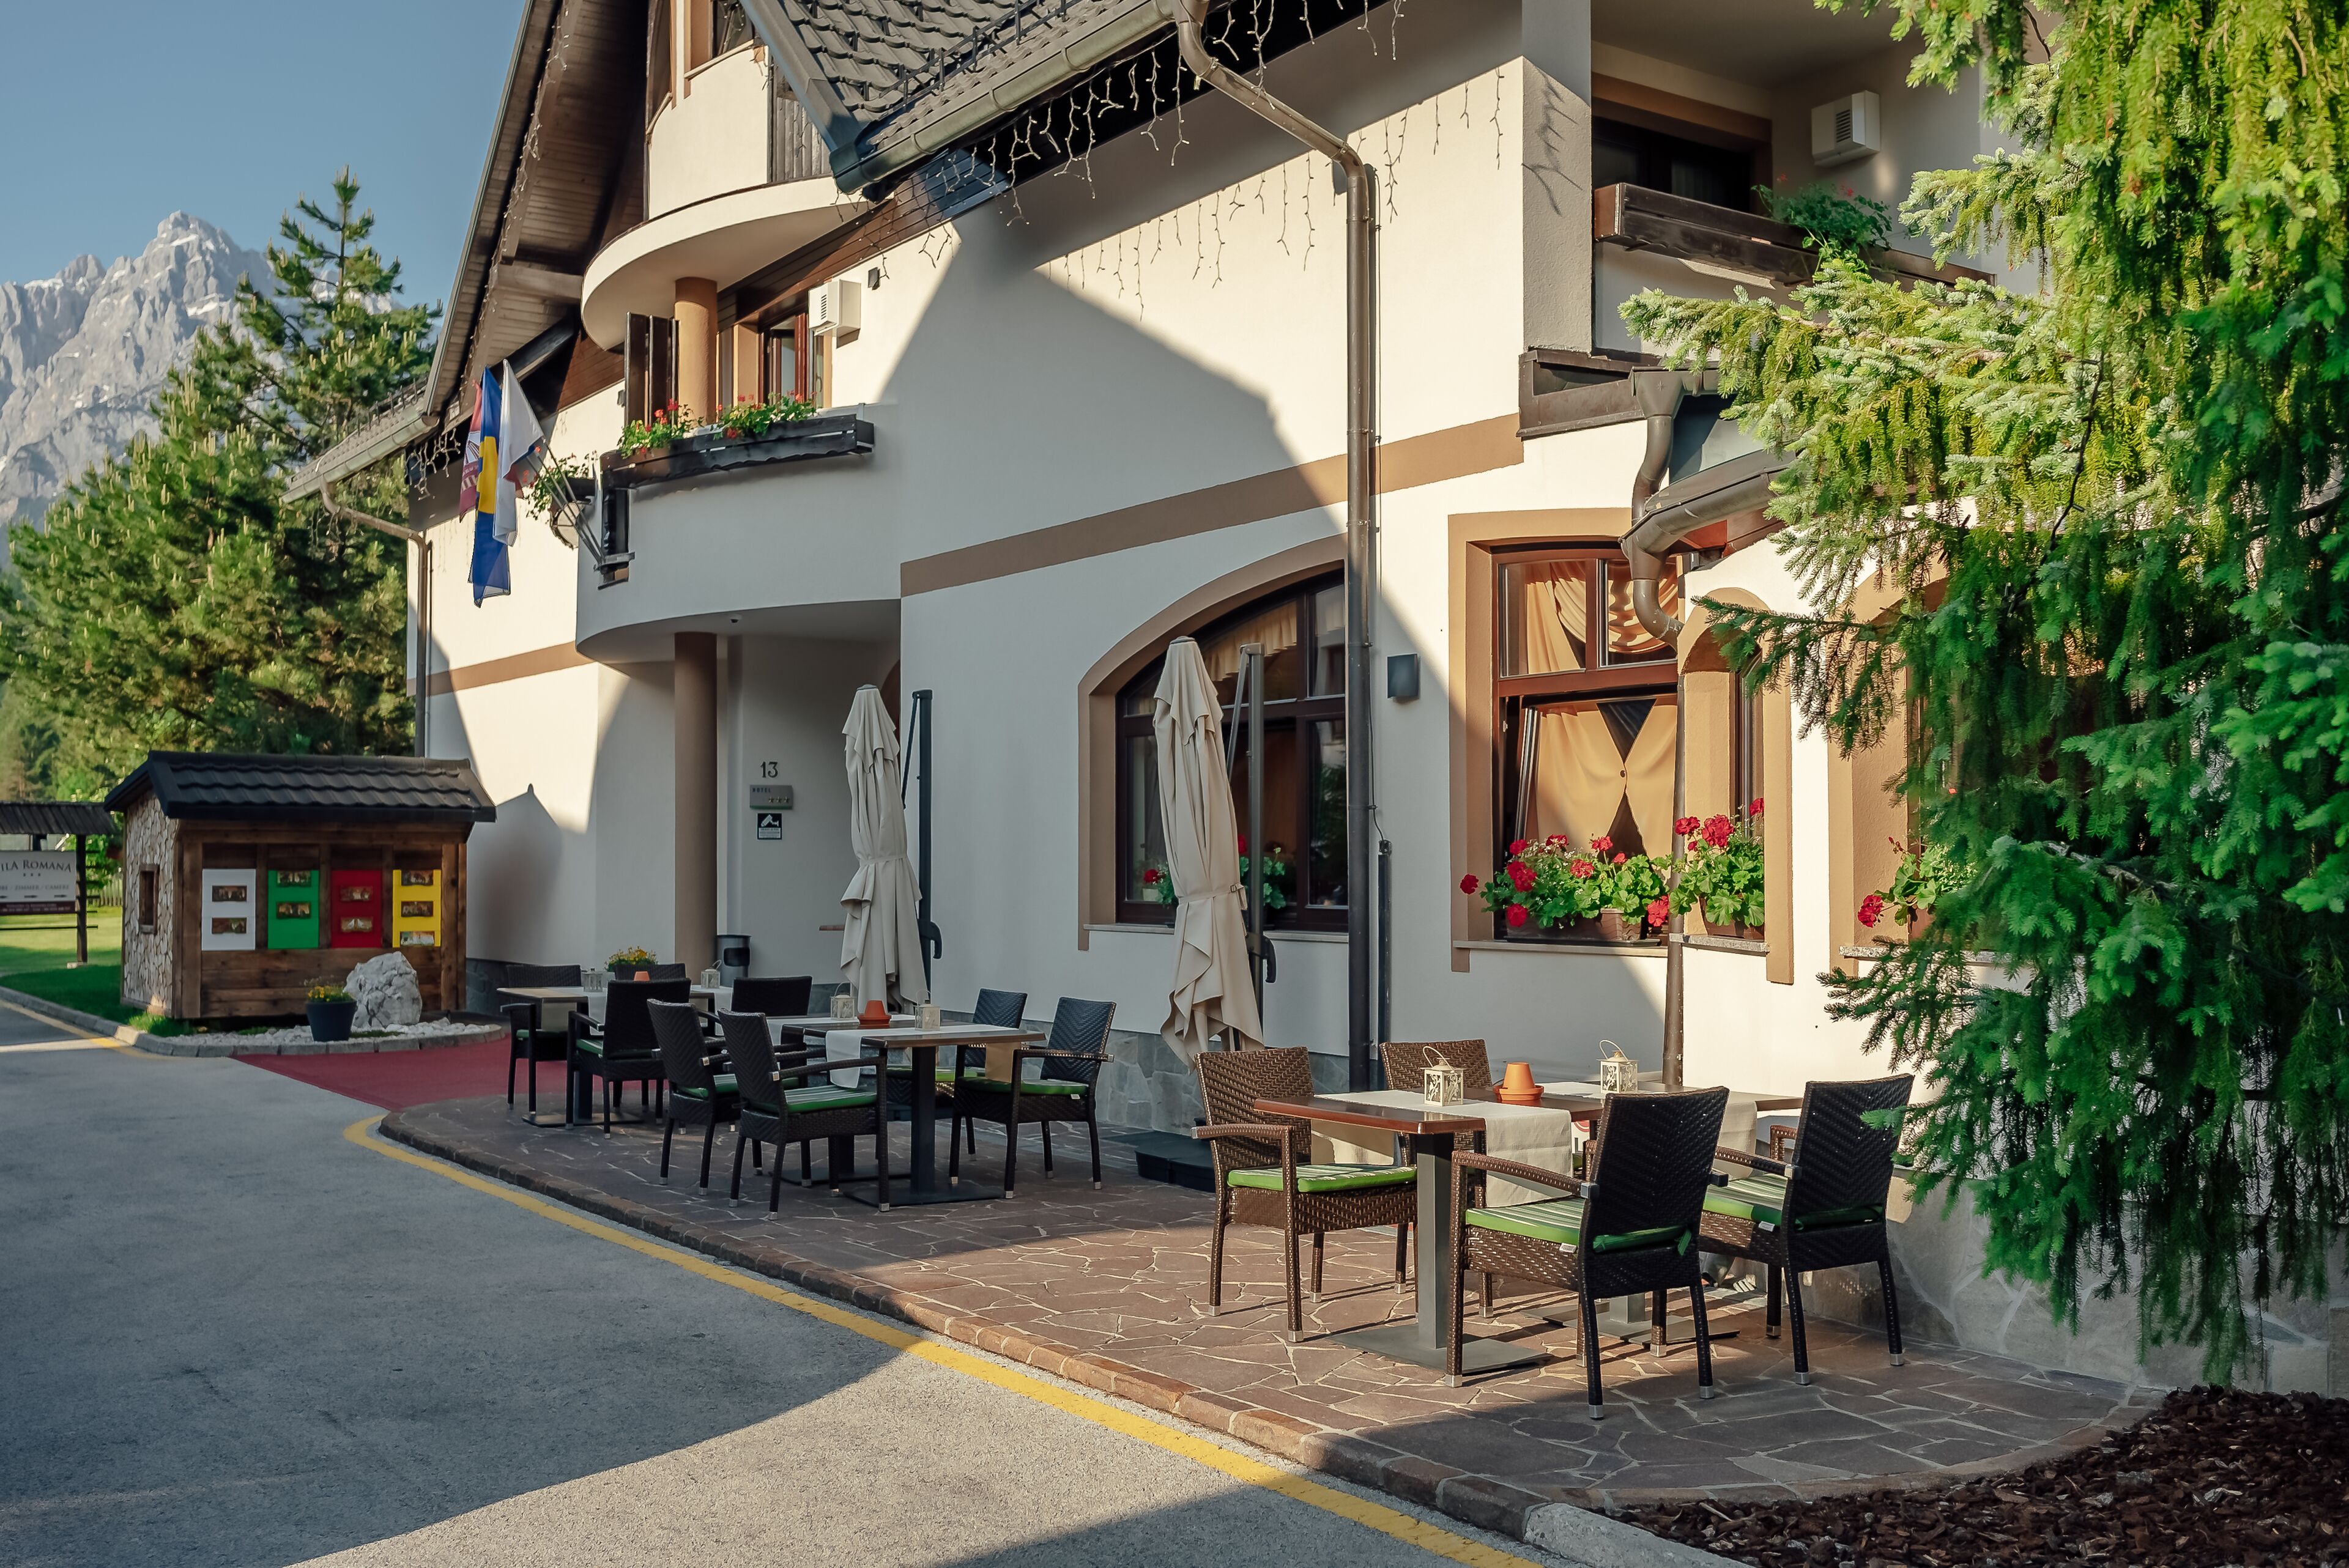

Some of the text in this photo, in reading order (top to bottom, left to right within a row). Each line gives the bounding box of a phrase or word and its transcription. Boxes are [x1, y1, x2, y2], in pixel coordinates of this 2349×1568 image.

[760, 761, 779, 778] 13
[1, 859, 72, 873] ILA ROMANA
